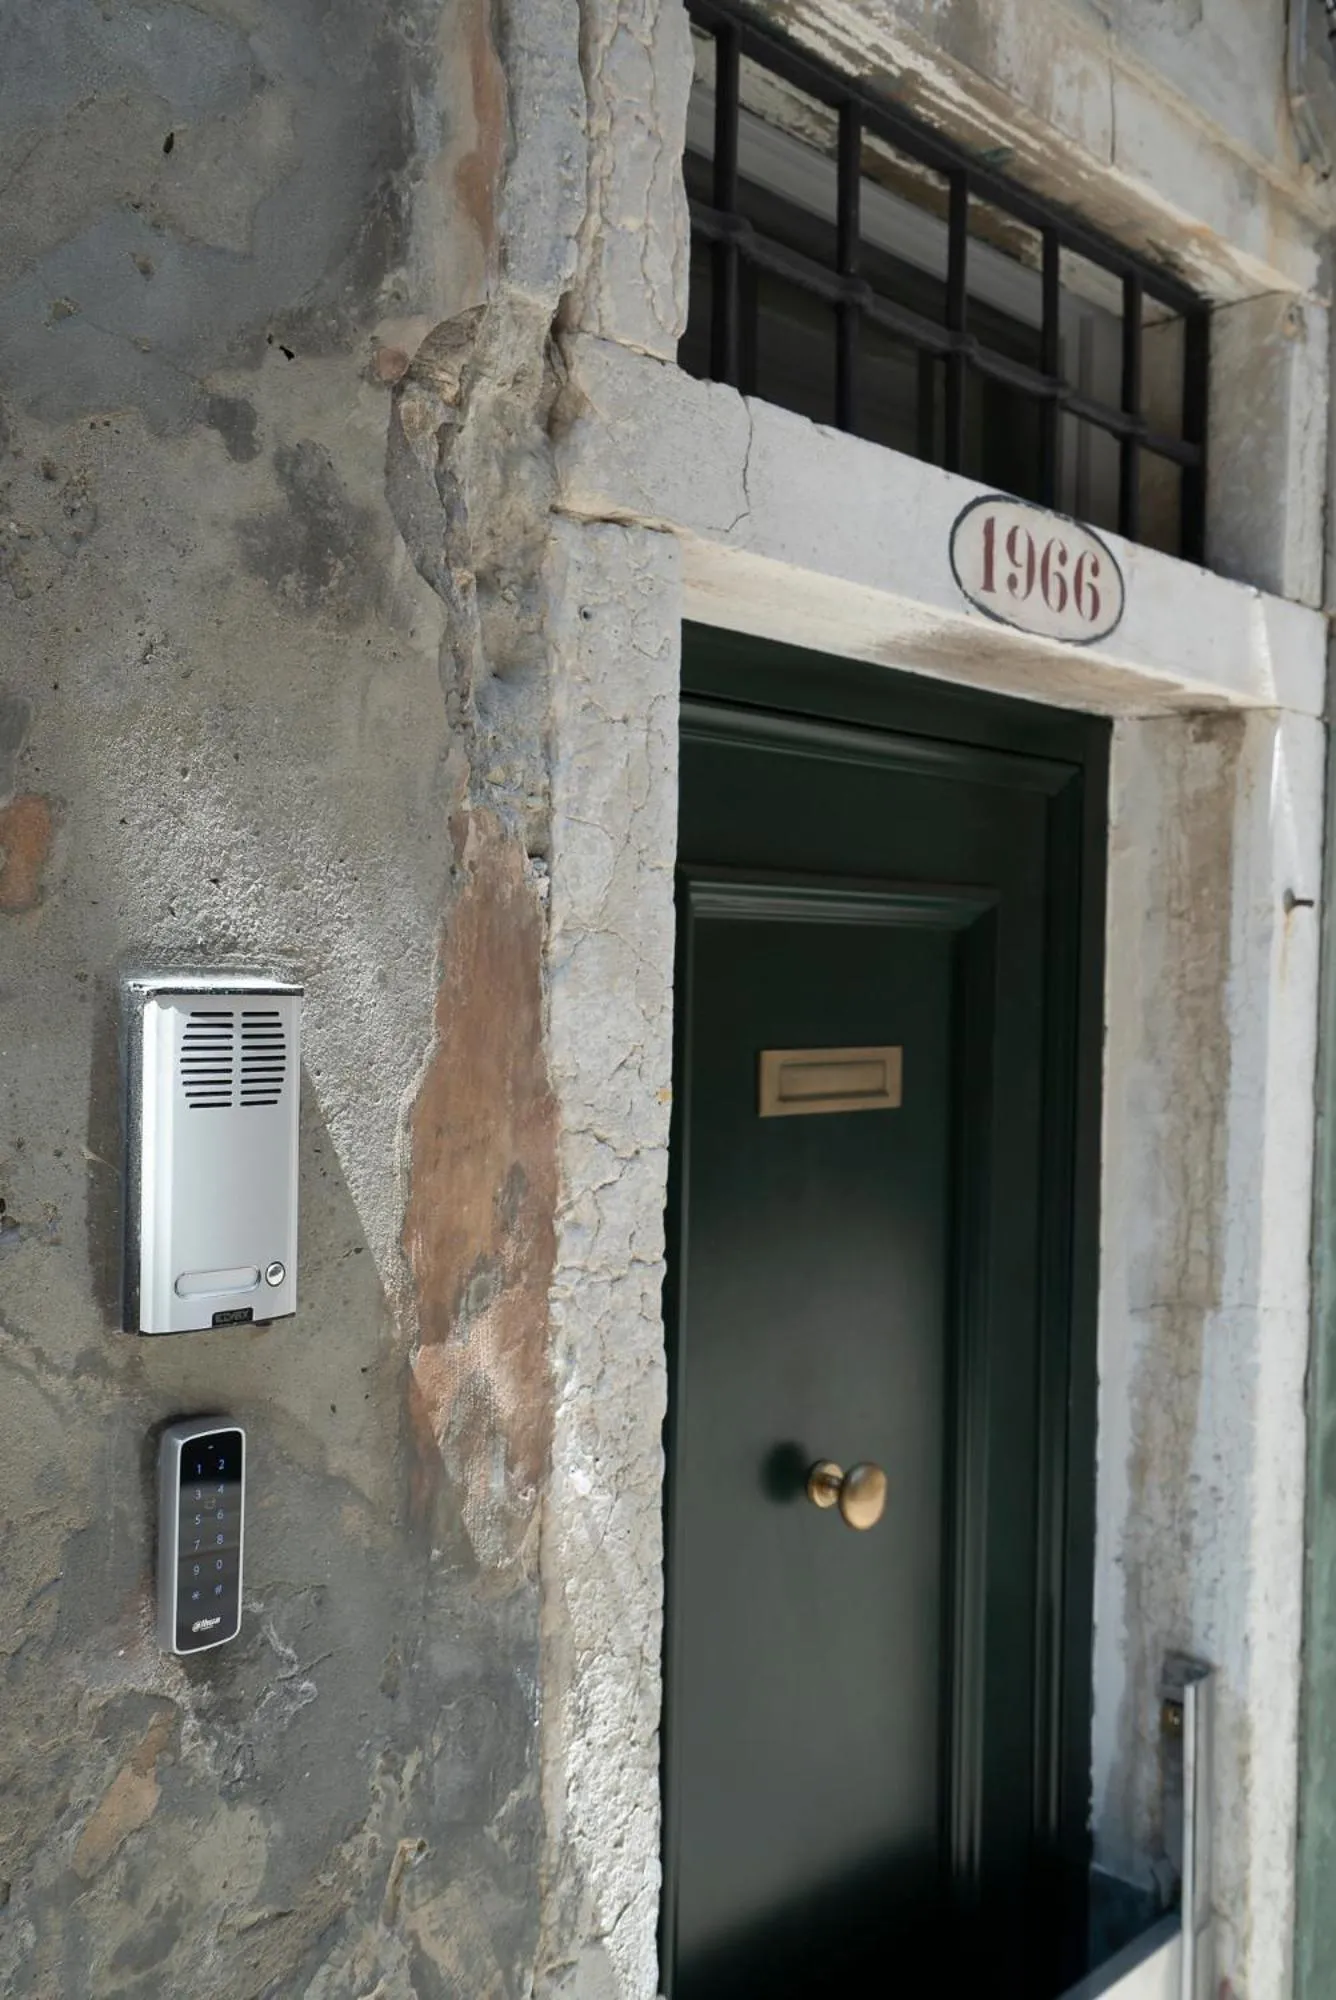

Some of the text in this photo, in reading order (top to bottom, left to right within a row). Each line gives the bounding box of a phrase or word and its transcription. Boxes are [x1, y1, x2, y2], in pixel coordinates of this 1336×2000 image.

[980, 516, 1100, 622] 1966
[196, 1459, 225, 1475] 1 2
[195, 1484, 224, 1500] 3 4
[195, 1514, 201, 1525] 5
[216, 1534, 223, 1545] 8
[193, 1559, 223, 1575] 9 0
